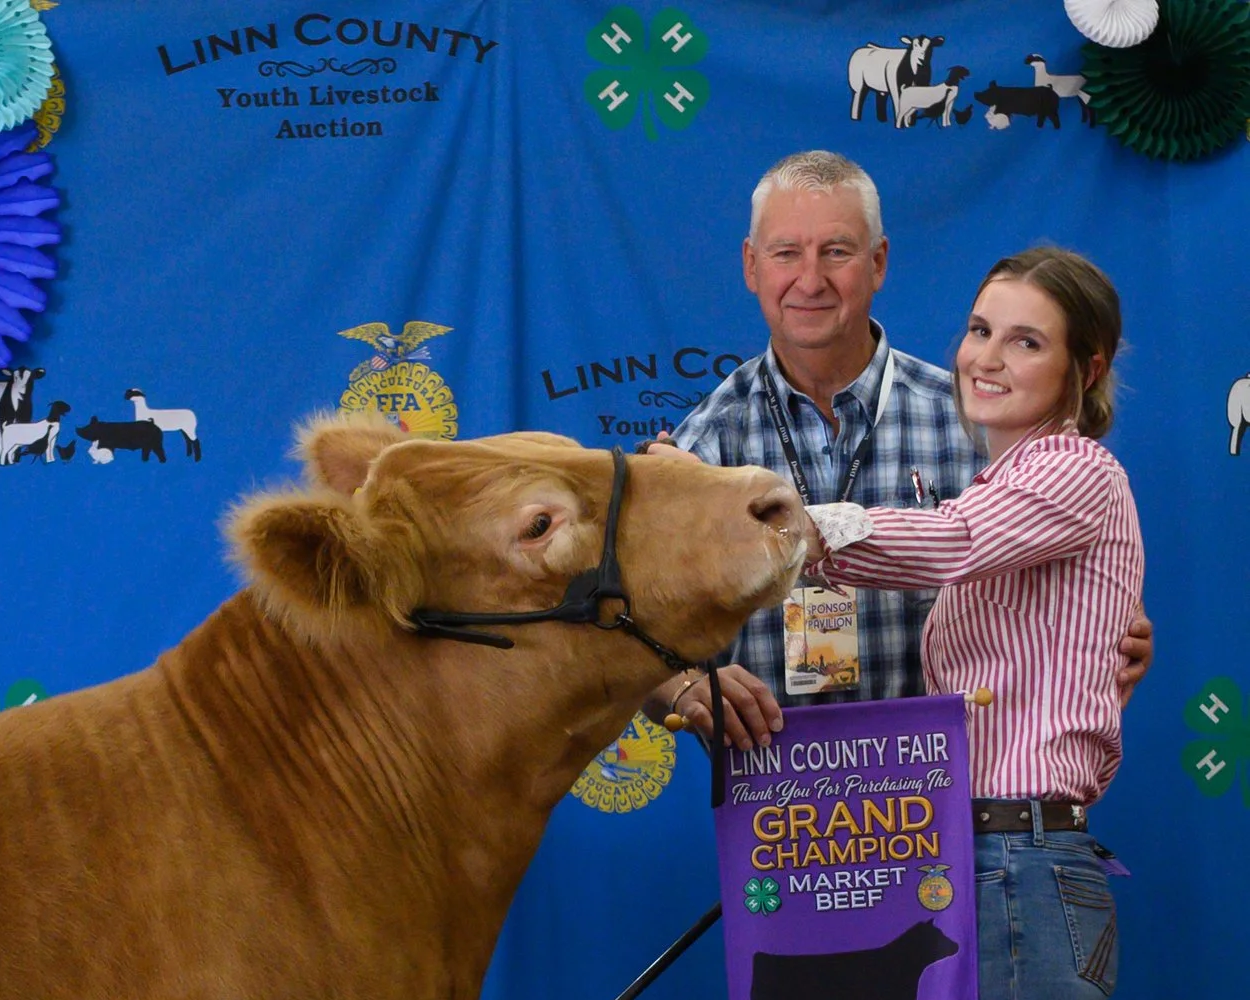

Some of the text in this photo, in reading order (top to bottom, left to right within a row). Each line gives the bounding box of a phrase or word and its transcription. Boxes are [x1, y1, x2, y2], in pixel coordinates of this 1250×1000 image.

[157, 13, 499, 77] LINN COUNTY
[216, 81, 440, 108] Youth Livestock
[275, 118, 383, 139] Auction
[541, 353, 659, 401] LINN
[376, 393, 421, 412] FFA
[807, 602, 853, 614] SPONSOR
[807, 617, 853, 630] PAVILION
[730, 733, 949, 777] LINN COUNTY FAIR
[732, 768, 952, 807] Thank You For Purchasing The
[752, 795, 934, 842] GRAND
[751, 832, 940, 870] CHAMPION
[789, 867, 907, 893] MARKET
[815, 889, 882, 911] BEEF
